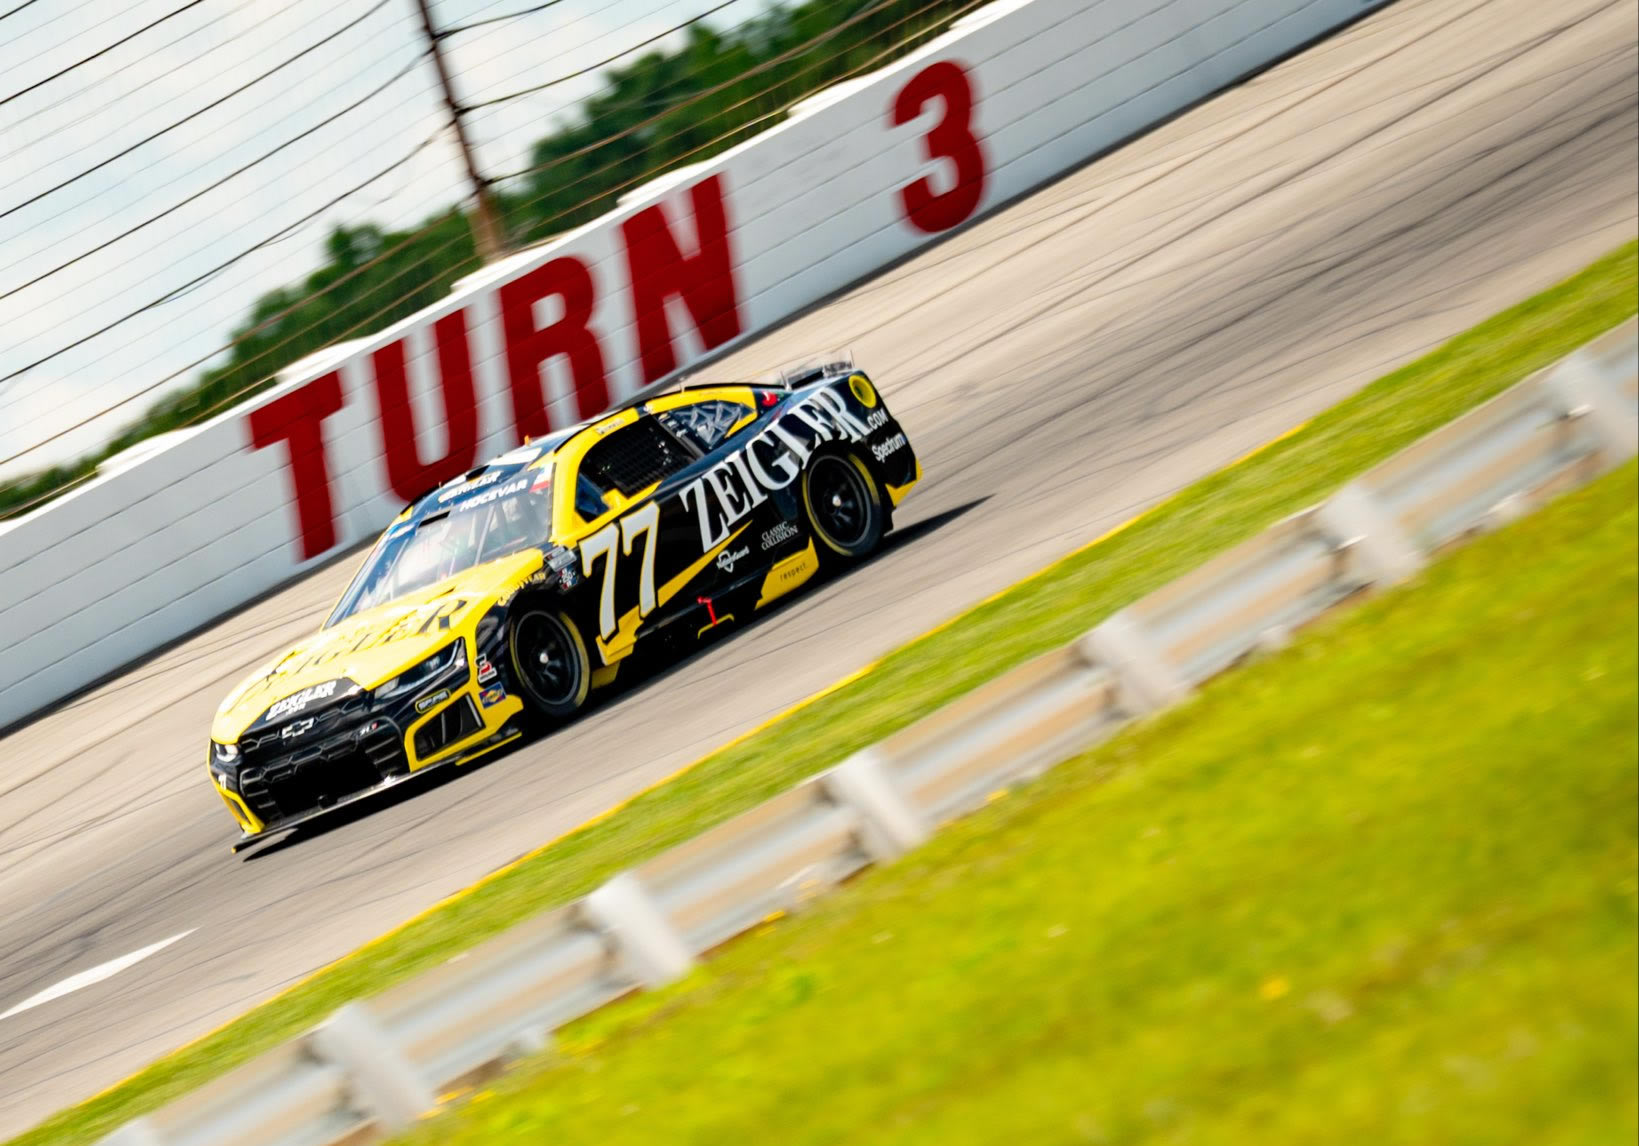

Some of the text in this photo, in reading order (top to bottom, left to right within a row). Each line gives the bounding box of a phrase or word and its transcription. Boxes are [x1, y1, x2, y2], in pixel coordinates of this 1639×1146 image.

[245, 59, 988, 562] TURN 3
[871, 432, 906, 463] Spectrum
[679, 387, 867, 553] ZEIGLER
[459, 479, 528, 512] HOCEVAR
[761, 521, 788, 541] CLASSIC
[761, 525, 798, 551] COLLISION
[579, 500, 660, 641] 77
